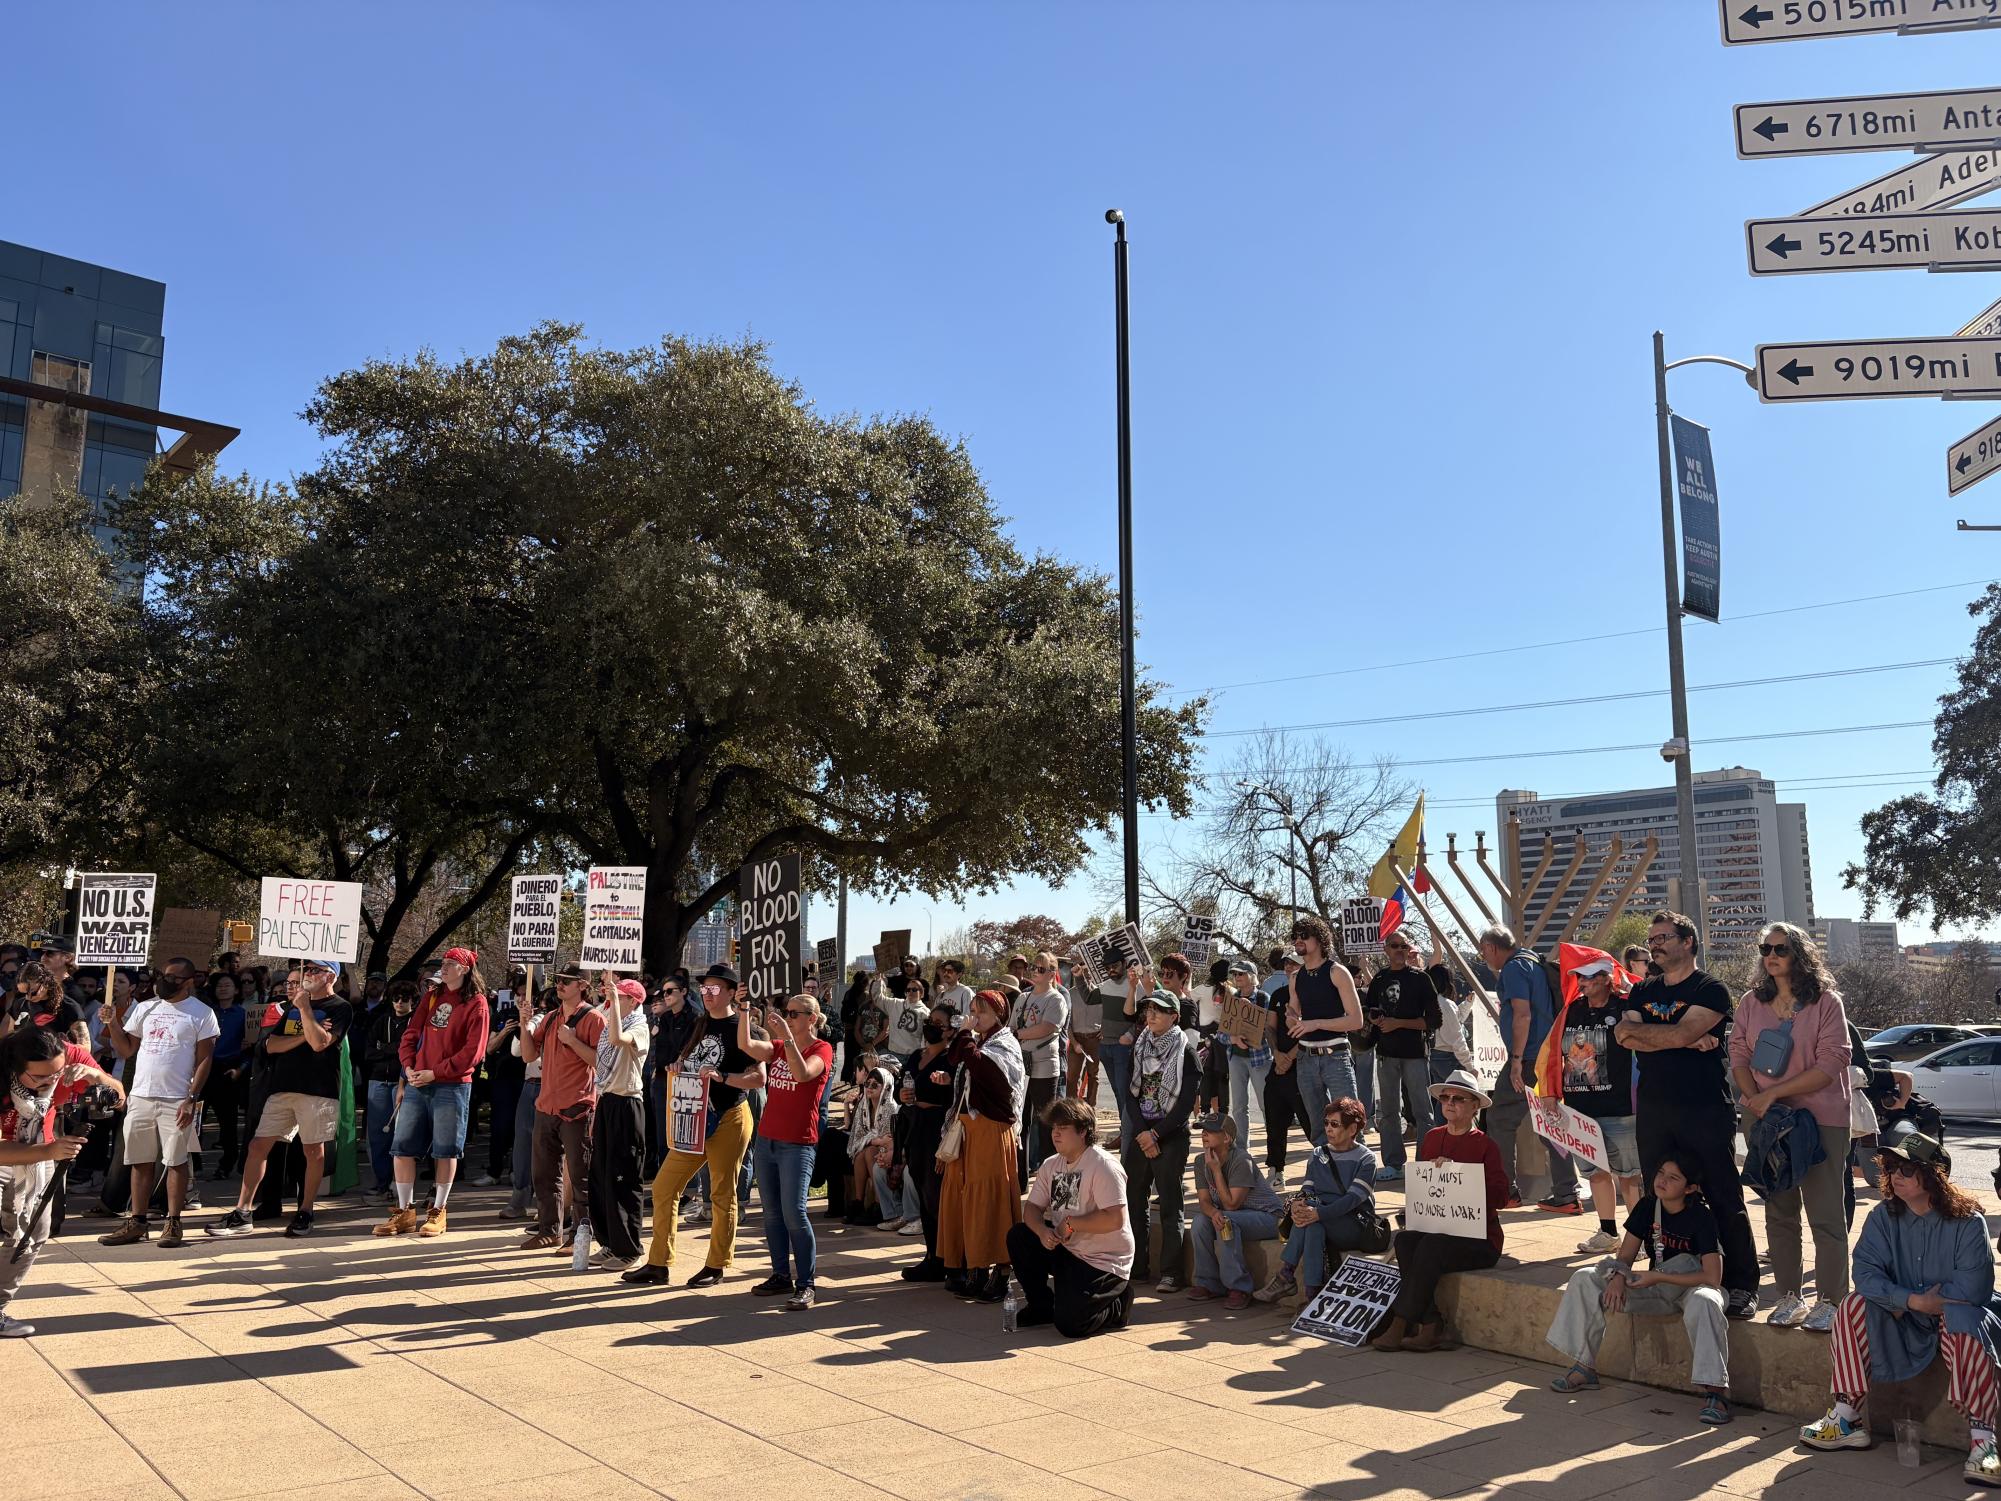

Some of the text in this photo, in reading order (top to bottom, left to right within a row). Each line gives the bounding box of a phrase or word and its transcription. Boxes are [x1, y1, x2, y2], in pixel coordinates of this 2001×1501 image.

[1805, 108, 1916, 138] 6718mi
[1939, 149, 1998, 190] Adel
[1818, 227, 1930, 256] 5245mi
[1834, 353, 1970, 382] 9019mi
[1685, 455, 1703, 474] WE
[1686, 470, 1707, 489] ALL
[1680, 483, 1715, 504] BELONG
[1515, 804, 1552, 817] HYATT
[1521, 816, 1552, 824] EGENCY
[516, 880, 558, 897] ¡DINERO
[590, 871, 645, 891] PALESTINE
[754, 860, 782, 898] NO
[82, 889, 150, 917] NO U.S.
[278, 883, 335, 916] FREE
[525, 894, 539, 902] PARA
[610, 892, 619, 902] to
[1349, 897, 1373, 907] NO
[514, 902, 557, 919] PUEBLO,
[741, 890, 800, 935] BLOOD
[1343, 906, 1380, 925] BLOOD
[81, 921, 149, 935] WAR
[513, 922, 555, 936] NO PARA
[589, 925, 640, 941] CAPITALISM
[1187, 916, 1213, 931] US
[80, 935, 146, 954] VENEZUELA
[260, 917, 350, 954] PALESTINE
[511, 937, 555, 948] LA GUERRA!
[1106, 929, 1130, 948] NO
[1184, 930, 1211, 941] OUT
[1344, 927, 1365, 944] FOR
[620, 948, 638, 964] ALL
[751, 929, 790, 969] FOR
[748, 962, 790, 999] OIL!
[1223, 995, 1265, 1026] US OUT
[770, 1067, 793, 1080] OVER
[672, 1076, 703, 1098] HANDS
[670, 1097, 703, 1114] OFF
[1573, 1114, 1598, 1137] THE
[1439, 1172, 1464, 1185] MUST
[1428, 1185, 1445, 1198] GO!
[1414, 1201, 1424, 1215] NO
[1425, 1202, 1446, 1218] MORE
[1335, 1265, 1400, 1295] VENEZUELA
[1325, 1280, 1391, 1307] WAR
[1309, 1294, 1383, 1332] NO U.S.
